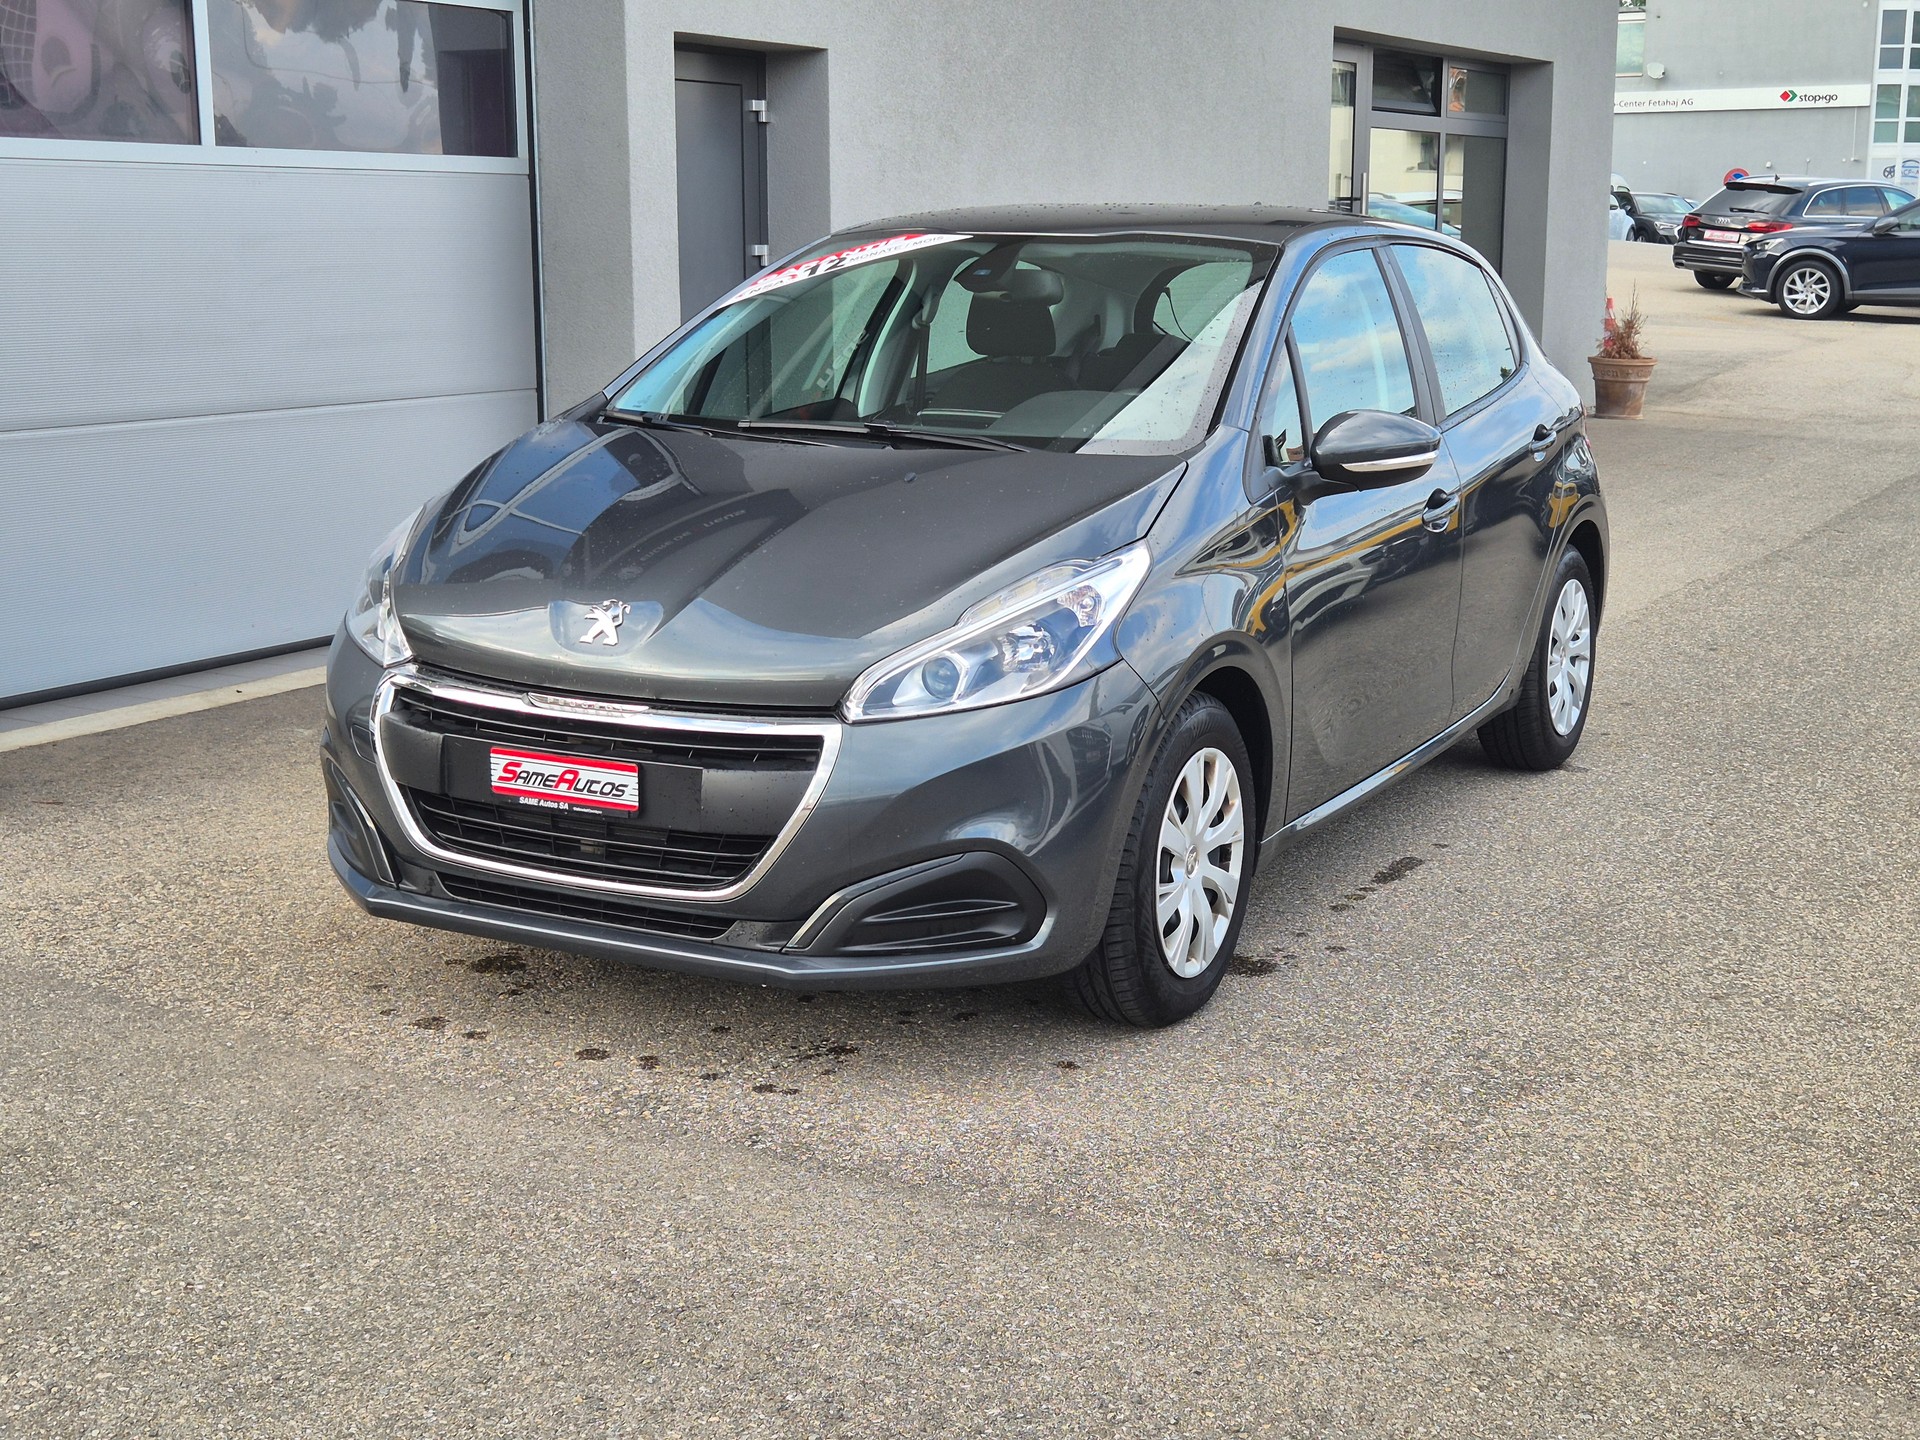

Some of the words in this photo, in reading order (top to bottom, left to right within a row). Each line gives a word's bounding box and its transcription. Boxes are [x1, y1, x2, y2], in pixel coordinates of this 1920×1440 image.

[1648, 99, 1679, 108] Fetahaj
[1681, 98, 1694, 106] AG
[1798, 94, 1838, 104] stop+go
[803, 257, 848, 277] 12
[849, 245, 900, 262] MONATE
[912, 236, 945, 246] MOIS
[519, 796, 539, 806] SAME
[539, 799, 558, 809] Autos
[559, 802, 569, 810] SA
